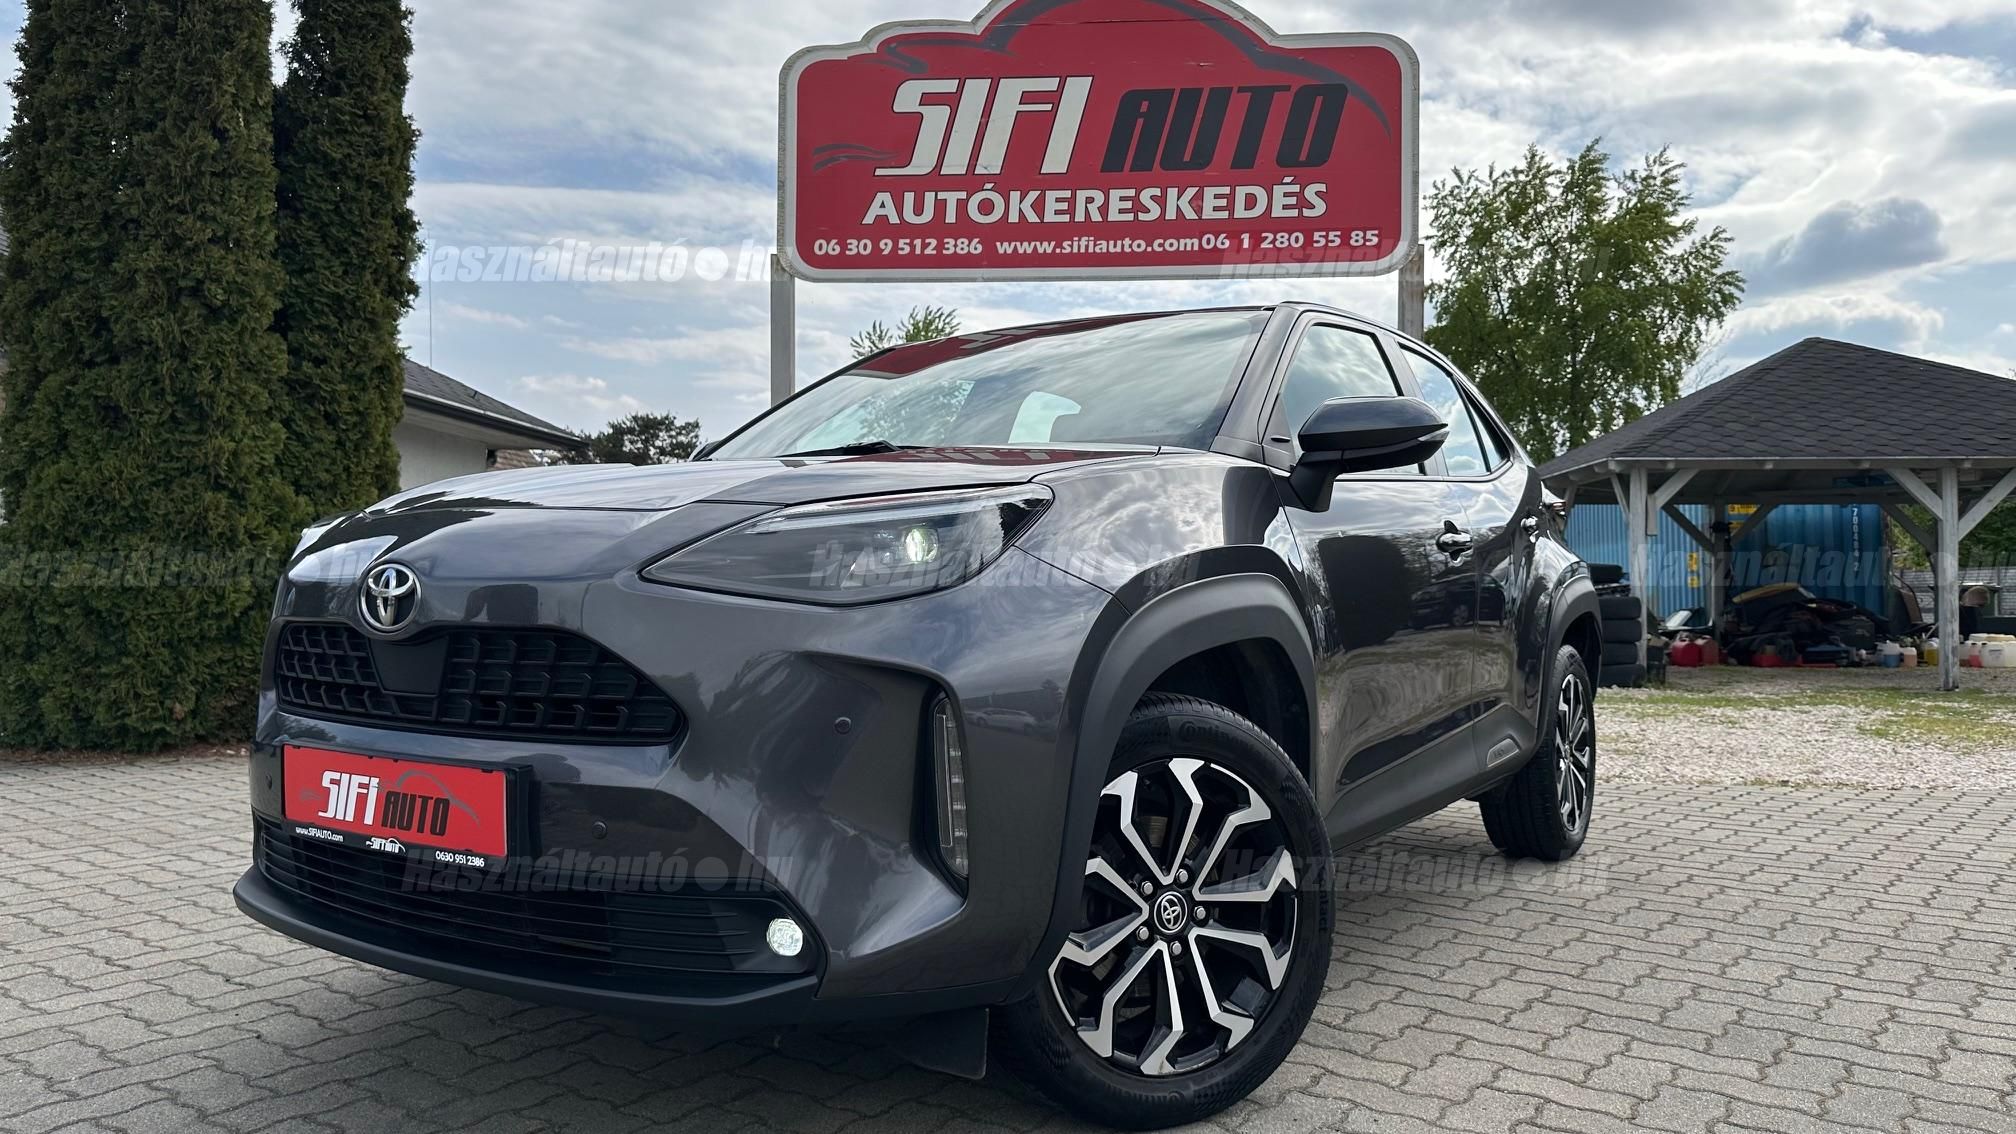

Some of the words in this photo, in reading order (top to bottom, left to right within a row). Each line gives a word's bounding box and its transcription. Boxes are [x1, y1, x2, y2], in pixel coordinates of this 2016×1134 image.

[873, 75, 1094, 177] SIFI
[1099, 83, 1349, 173] AUTO
[861, 177, 1328, 225] AUTÓKERESKEDÉS
[813, 238, 840, 256] 06
[845, 238, 872, 255] 30
[898, 238, 937, 255] 512
[942, 237, 983, 255] 386
[995, 236, 1199, 254] www.sifiauto.com
[1260, 231, 1304, 249] 280
[1312, 231, 1342, 247] 55
[1349, 229, 1379, 247] 85
[317, 770, 381, 826] SIFI
[381, 790, 451, 837] AUTO
[435, 850, 454, 863] 0630
